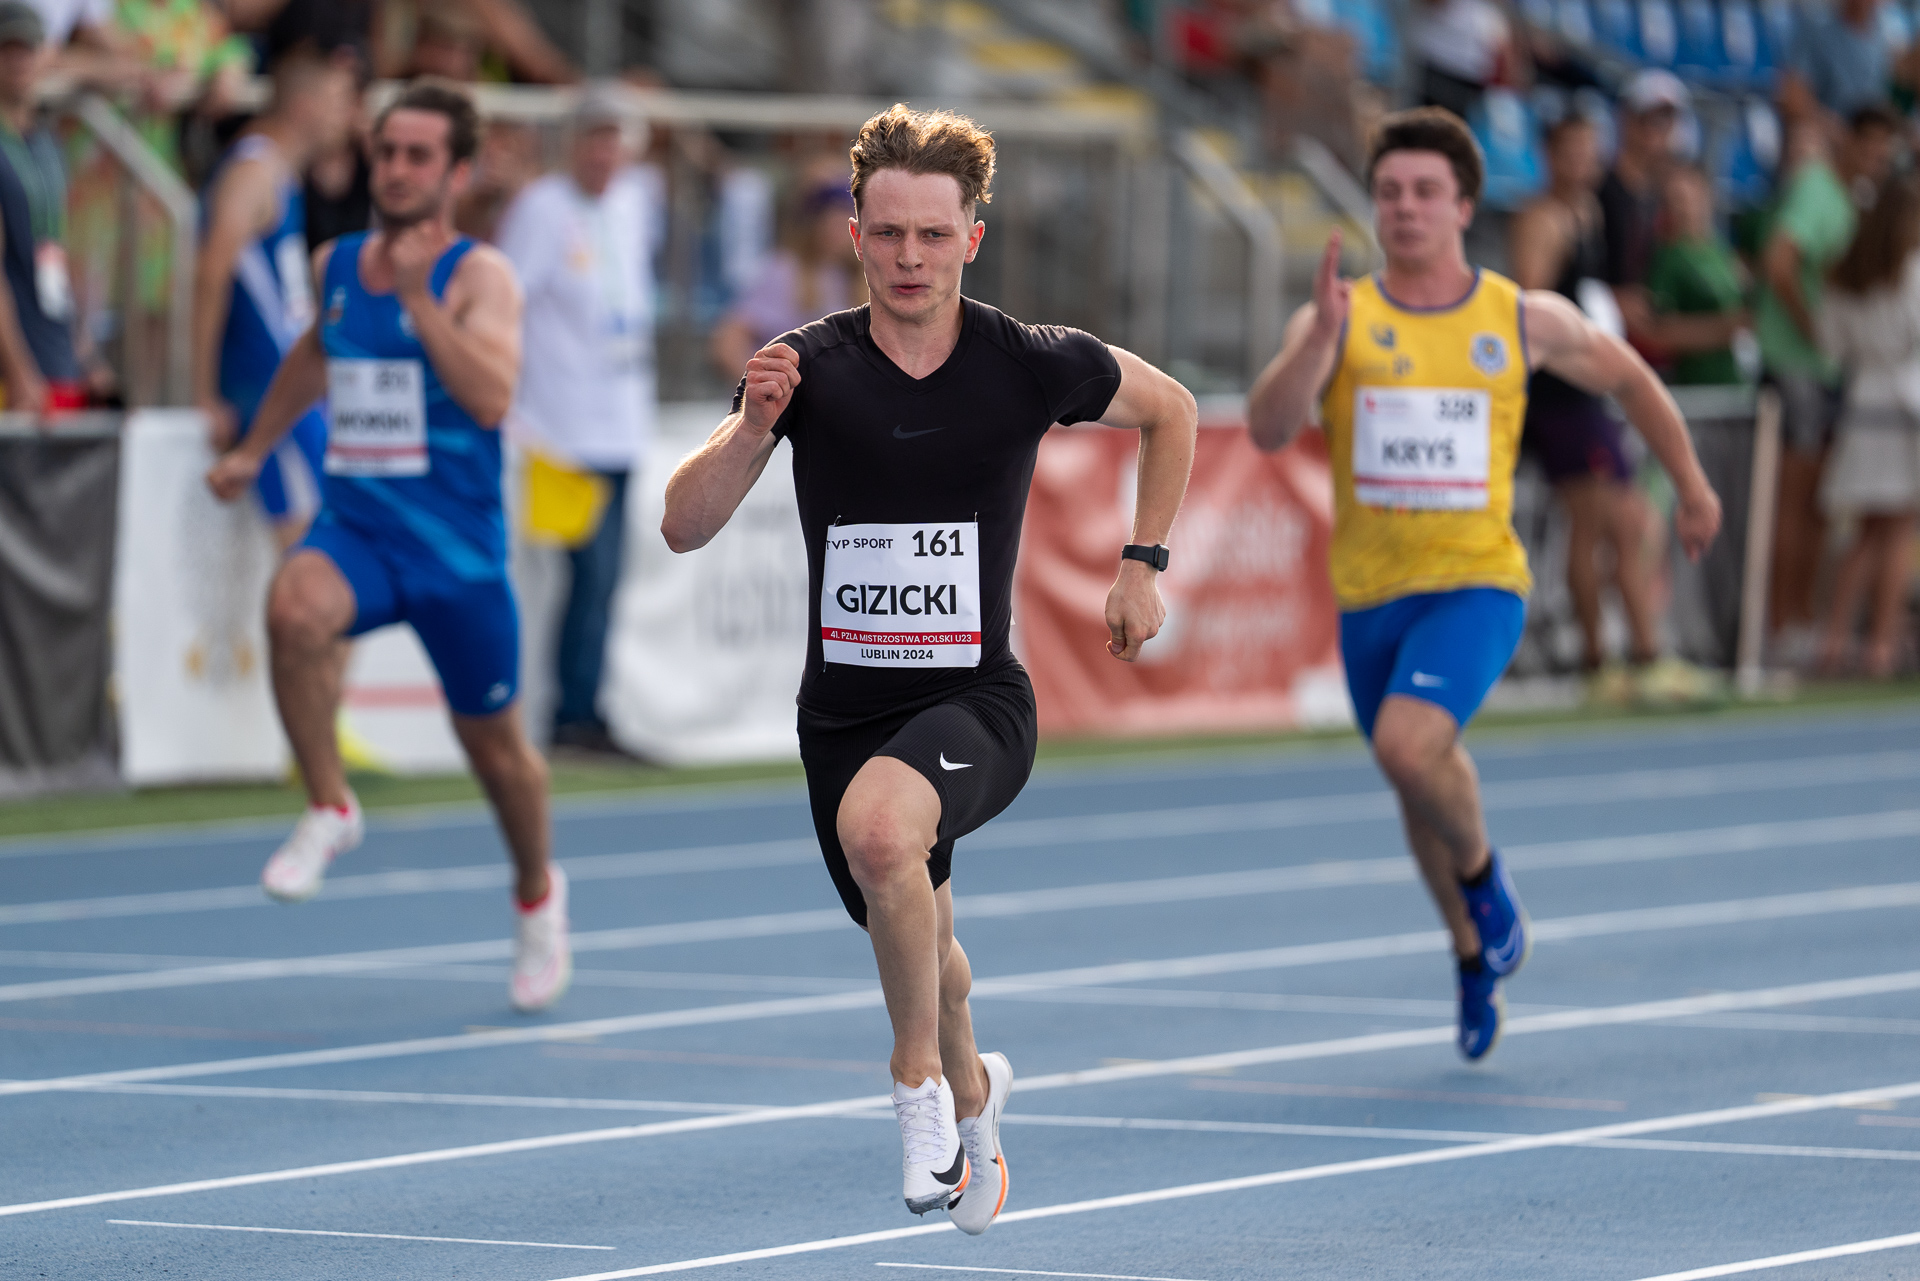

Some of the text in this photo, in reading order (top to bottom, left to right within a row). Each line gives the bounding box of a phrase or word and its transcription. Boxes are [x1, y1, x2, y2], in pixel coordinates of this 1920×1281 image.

[826, 538, 894, 550] TVP SPORT
[912, 529, 964, 557] 161
[836, 584, 957, 616] GIZICKI
[830, 630, 972, 643] 41. PZLA MISTRZOSTWA POLSKI U23
[861, 648, 934, 660] LUBLIN 2024
